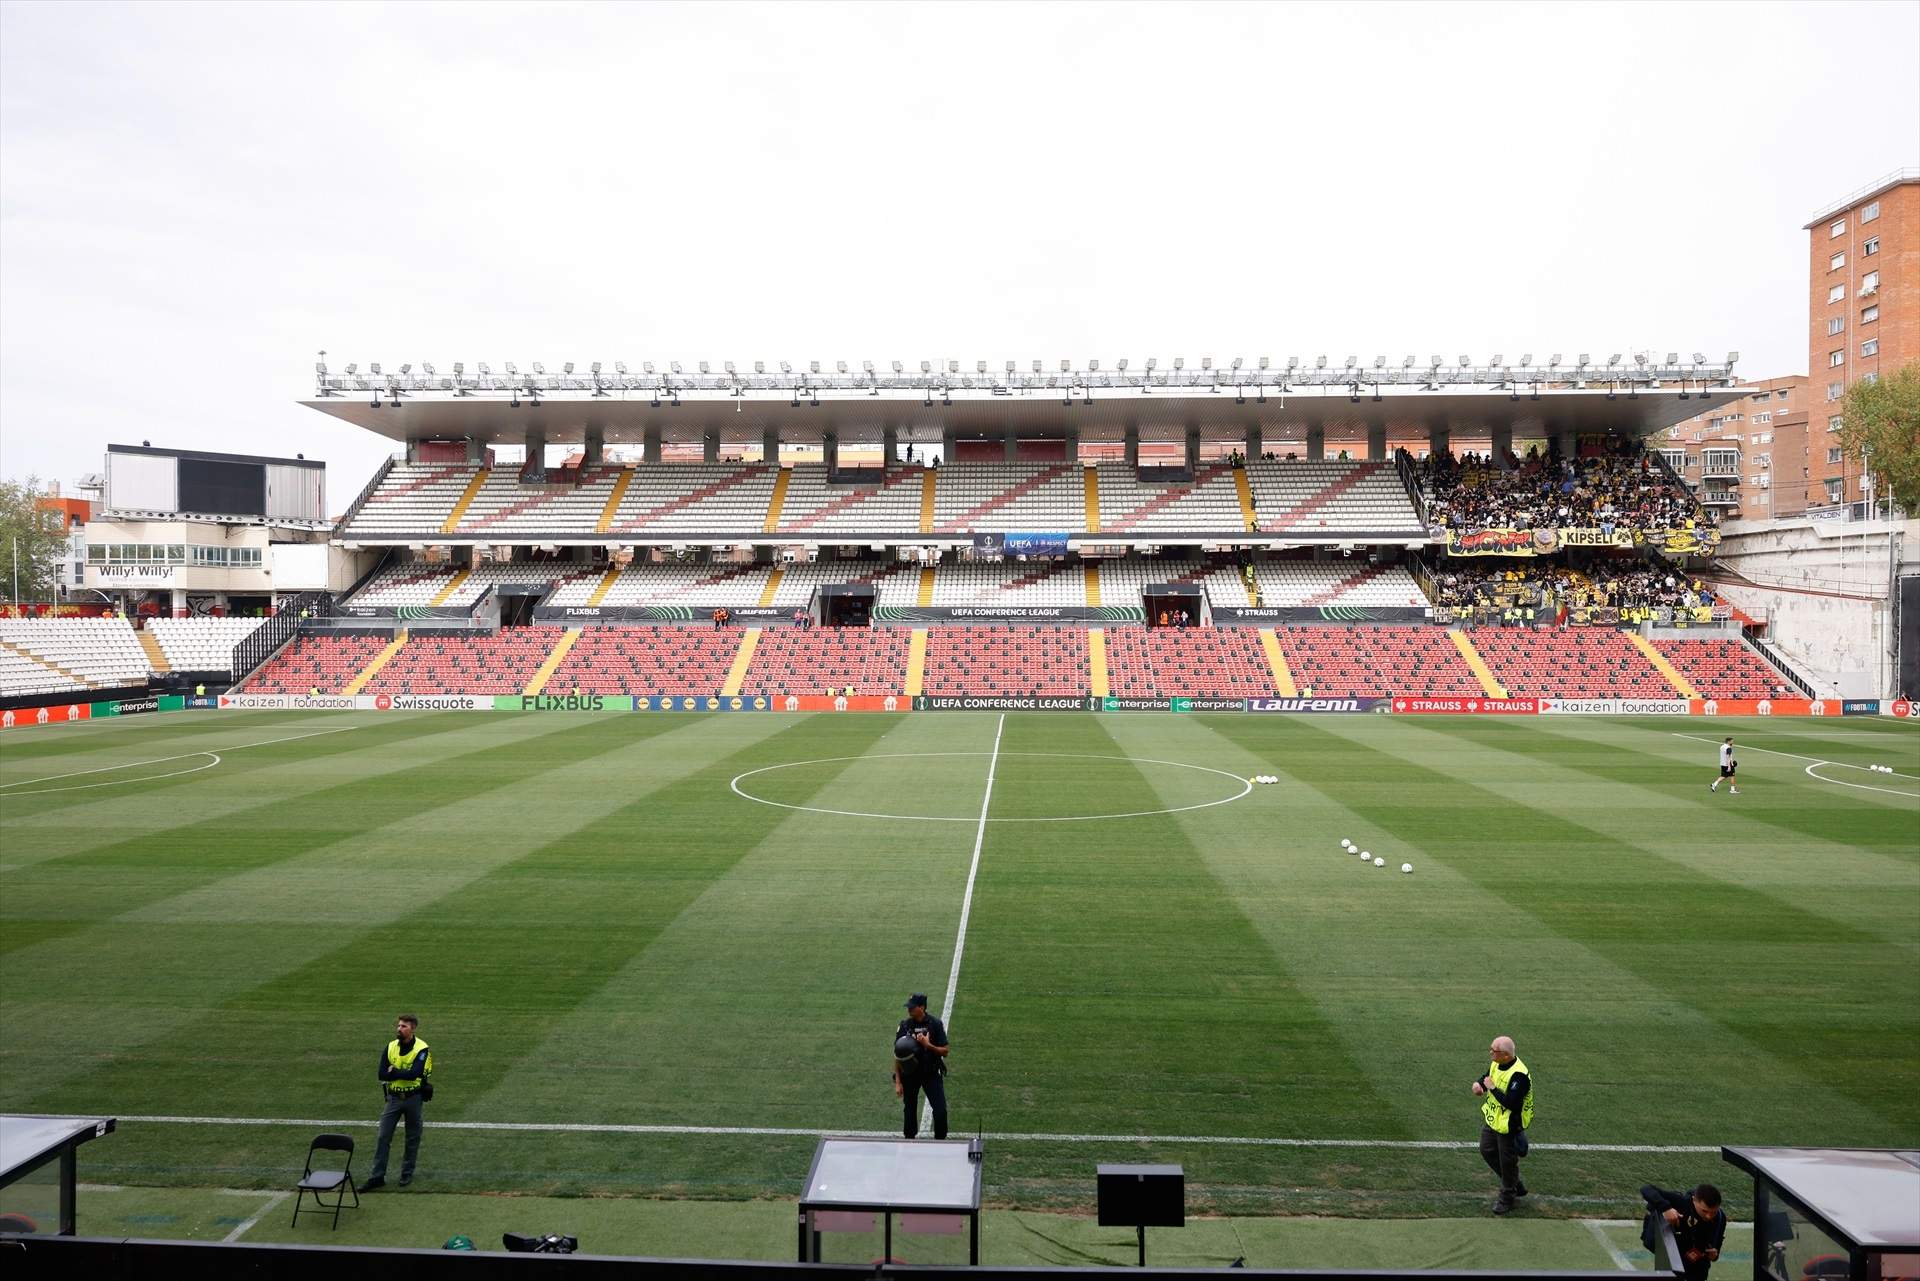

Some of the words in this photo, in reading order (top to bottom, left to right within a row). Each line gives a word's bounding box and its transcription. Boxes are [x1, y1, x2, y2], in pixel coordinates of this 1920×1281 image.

[1566, 533, 1613, 544] KIPSELI
[100, 565, 134, 577] Willy!
[139, 565, 173, 578] Willy!
[951, 608, 973, 616] UEFA
[974, 608, 1027, 616] CONFERENCE
[1028, 608, 1061, 616] LEAGUE
[111, 700, 158, 712] enterprise
[239, 696, 284, 708] kaizen
[294, 696, 353, 708] foundation
[393, 696, 474, 710] Swissquote
[932, 698, 962, 709] UEFA
[964, 698, 1036, 709] CONFERENCE
[1038, 698, 1081, 709] LEAGUE
[1107, 700, 1170, 710] enterprise
[1180, 700, 1243, 710] enterprise
[1411, 701, 1462, 710] STRAUSS
[1483, 701, 1534, 711] STRAUSS
[1561, 700, 1611, 712] kaizen
[1621, 701, 1687, 713] foundation
